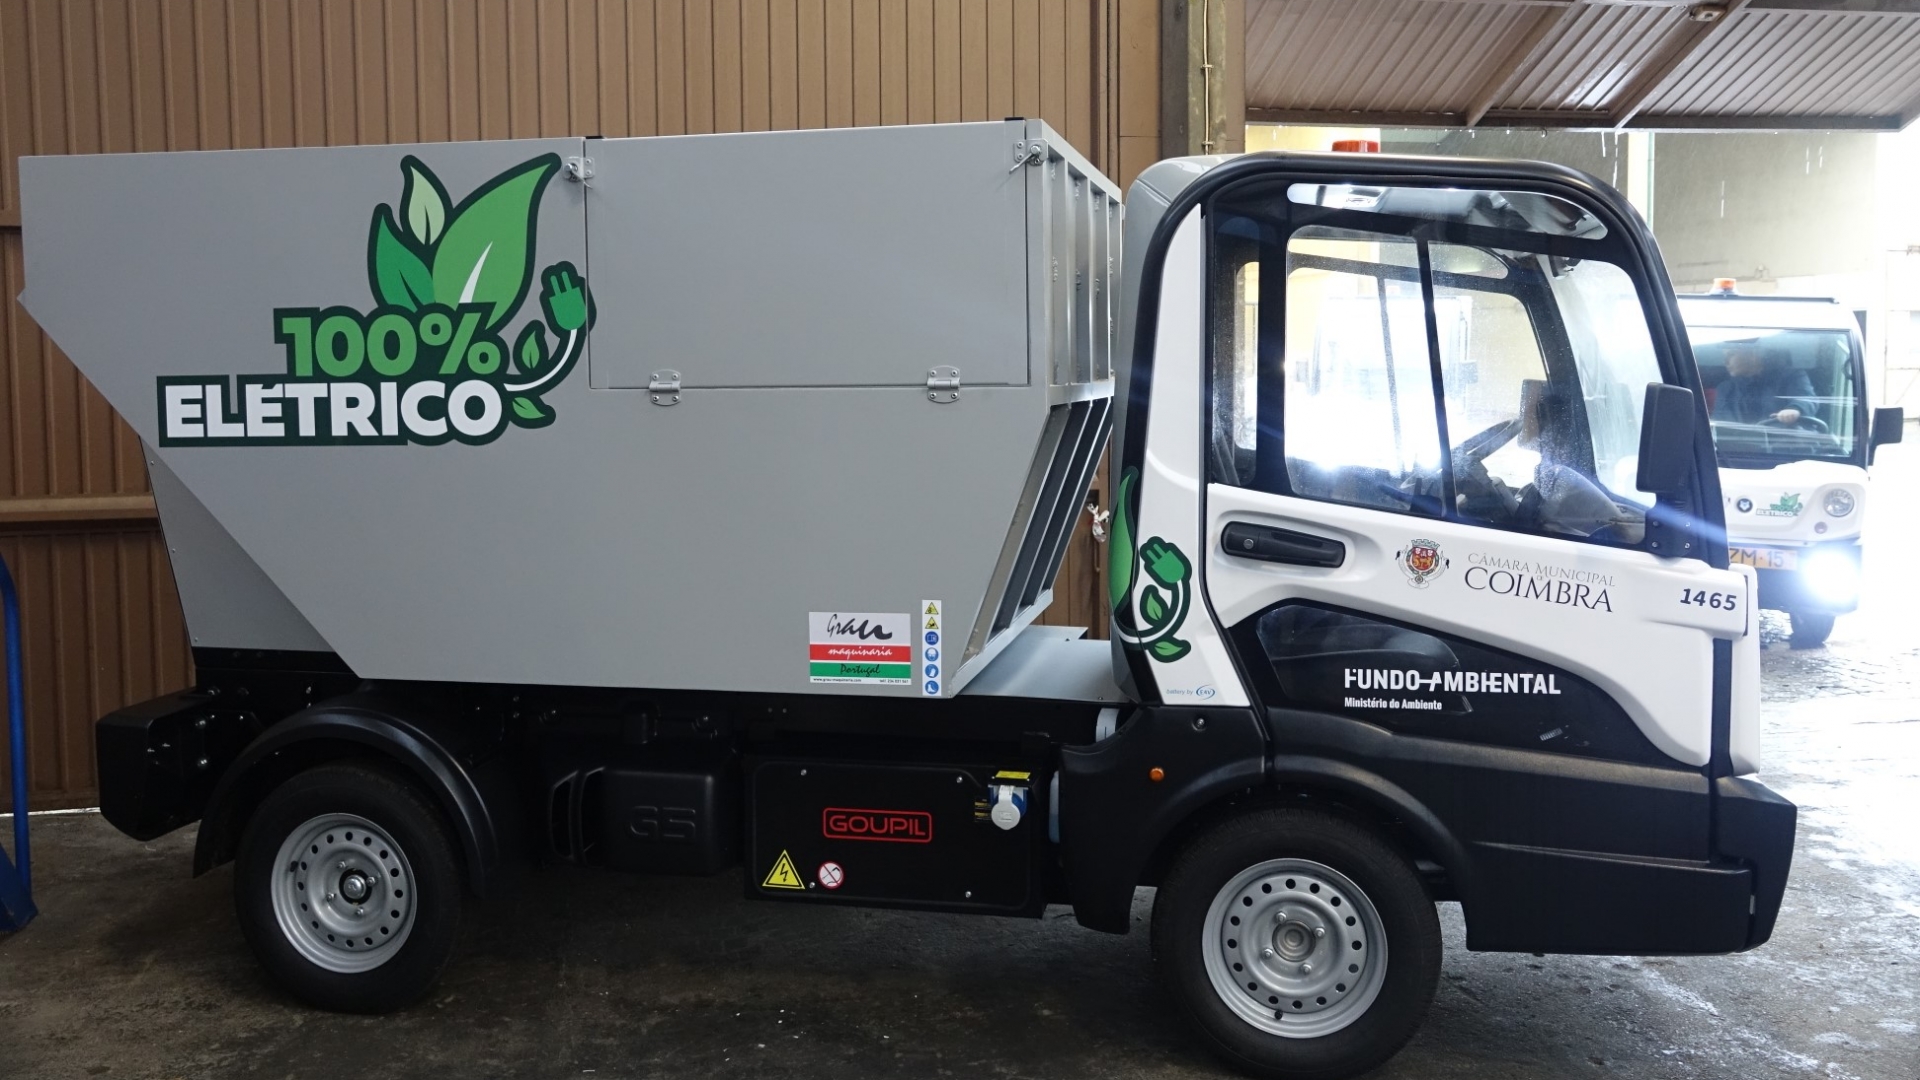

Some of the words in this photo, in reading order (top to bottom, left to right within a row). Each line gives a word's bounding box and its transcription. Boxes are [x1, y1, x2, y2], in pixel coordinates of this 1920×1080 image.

[282, 312, 502, 377] 100%
[165, 379, 503, 439] ELÉTRICO
[1467, 552, 1530, 573] CÂMARA
[1535, 562, 1616, 587] MUNICIPAL
[1464, 566, 1613, 613] COIMBRA
[1680, 588, 1738, 612] 1465
[827, 645, 893, 660] maquinaria
[840, 663, 881, 677] Portugal
[1344, 697, 1387, 709] Ministério
[1389, 698, 1400, 709] do
[1401, 698, 1443, 710] Ambiente
[828, 814, 926, 836] GOUPIL
